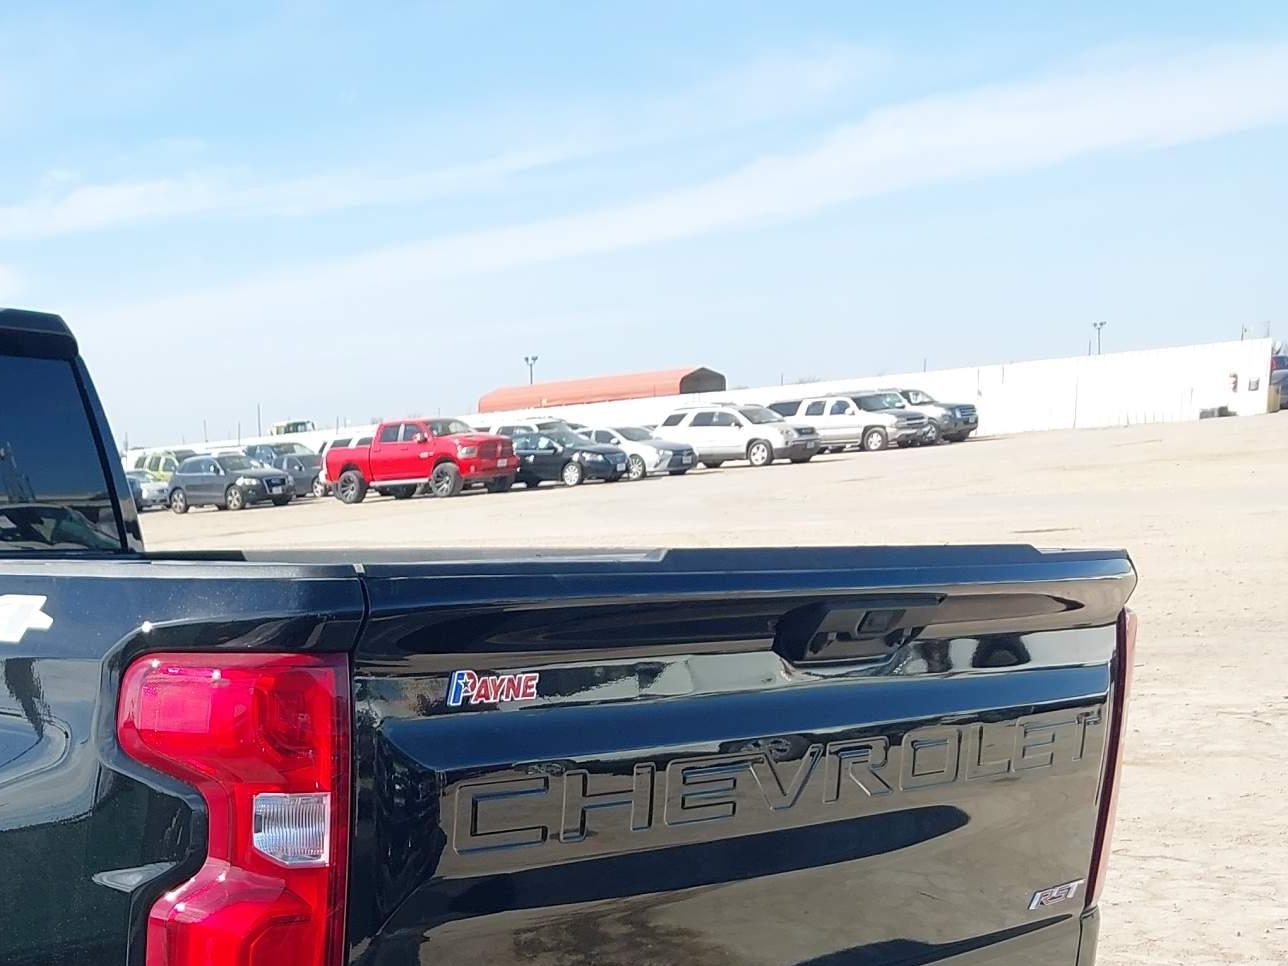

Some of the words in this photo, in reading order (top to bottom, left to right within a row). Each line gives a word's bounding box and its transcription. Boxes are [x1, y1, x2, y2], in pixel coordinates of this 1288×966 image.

[447, 670, 539, 705] PAYNE
[453, 703, 1103, 857] CHEVROLET
[1028, 879, 1085, 910] RST
